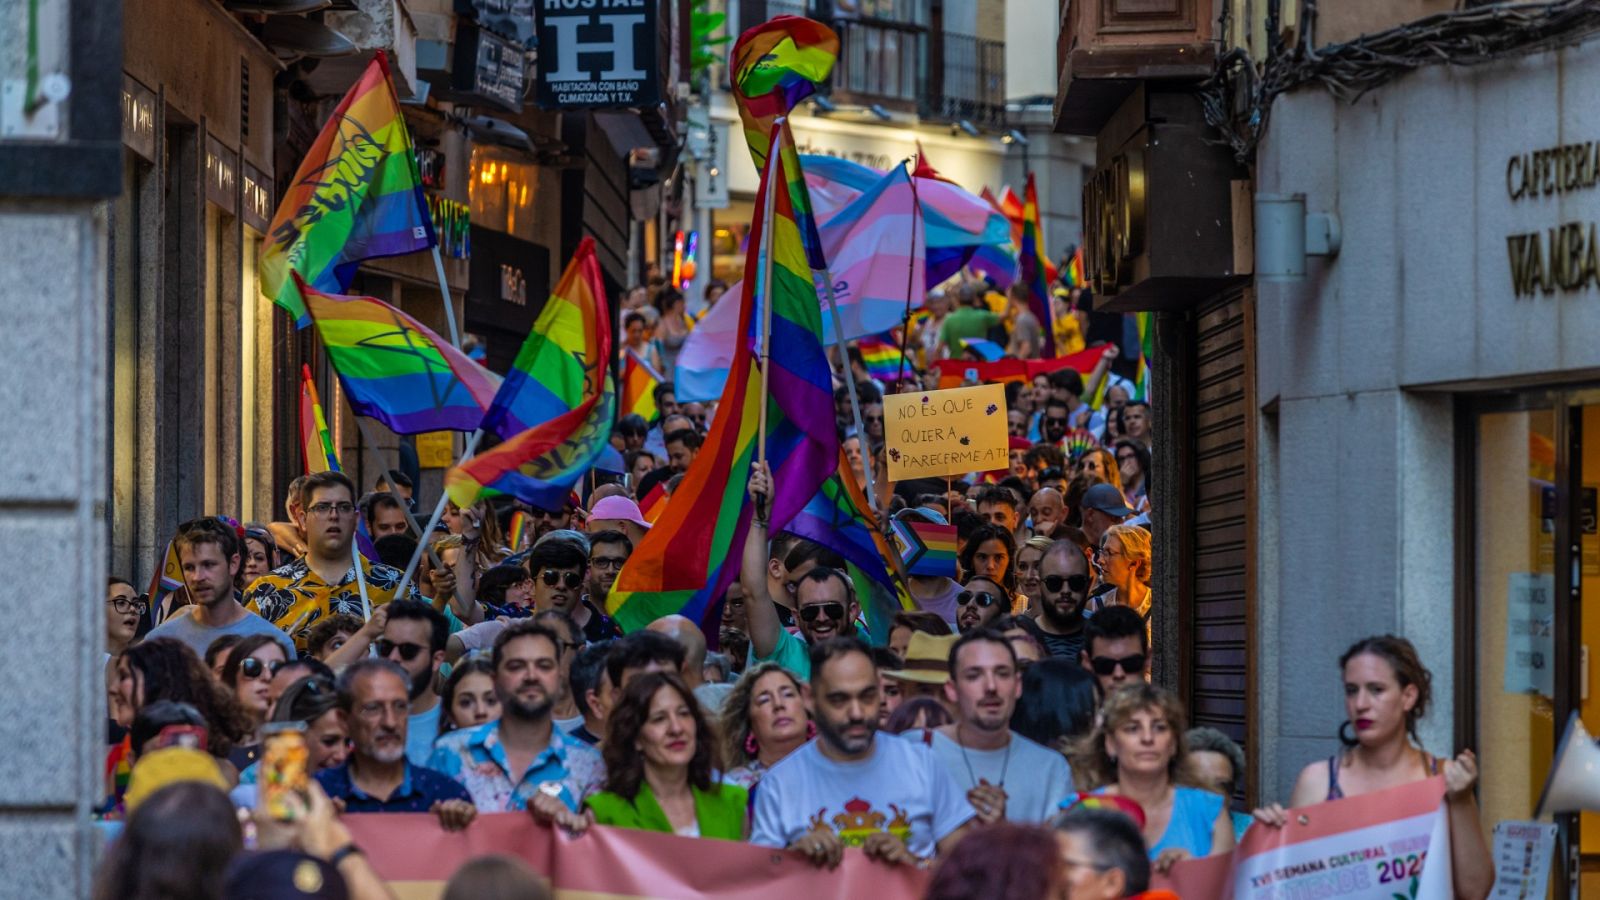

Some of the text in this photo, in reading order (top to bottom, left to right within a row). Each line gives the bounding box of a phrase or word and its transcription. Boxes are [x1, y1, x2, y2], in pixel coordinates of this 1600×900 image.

[544, 0, 645, 9] HOSTAL
[544, 14, 647, 82] H
[598, 82, 616, 91] CON
[616, 80, 639, 91] BAÑO
[558, 92, 633, 103] CLIMATIZADA Y T.V.
[898, 398, 974, 420] NO ES QUE
[901, 426, 957, 444] QUIERA
[902, 450, 981, 468] PARECERME
[984, 448, 994, 461] A
[1274, 860, 1326, 881] SEMANA
[1328, 846, 1387, 868] CULTURAL
